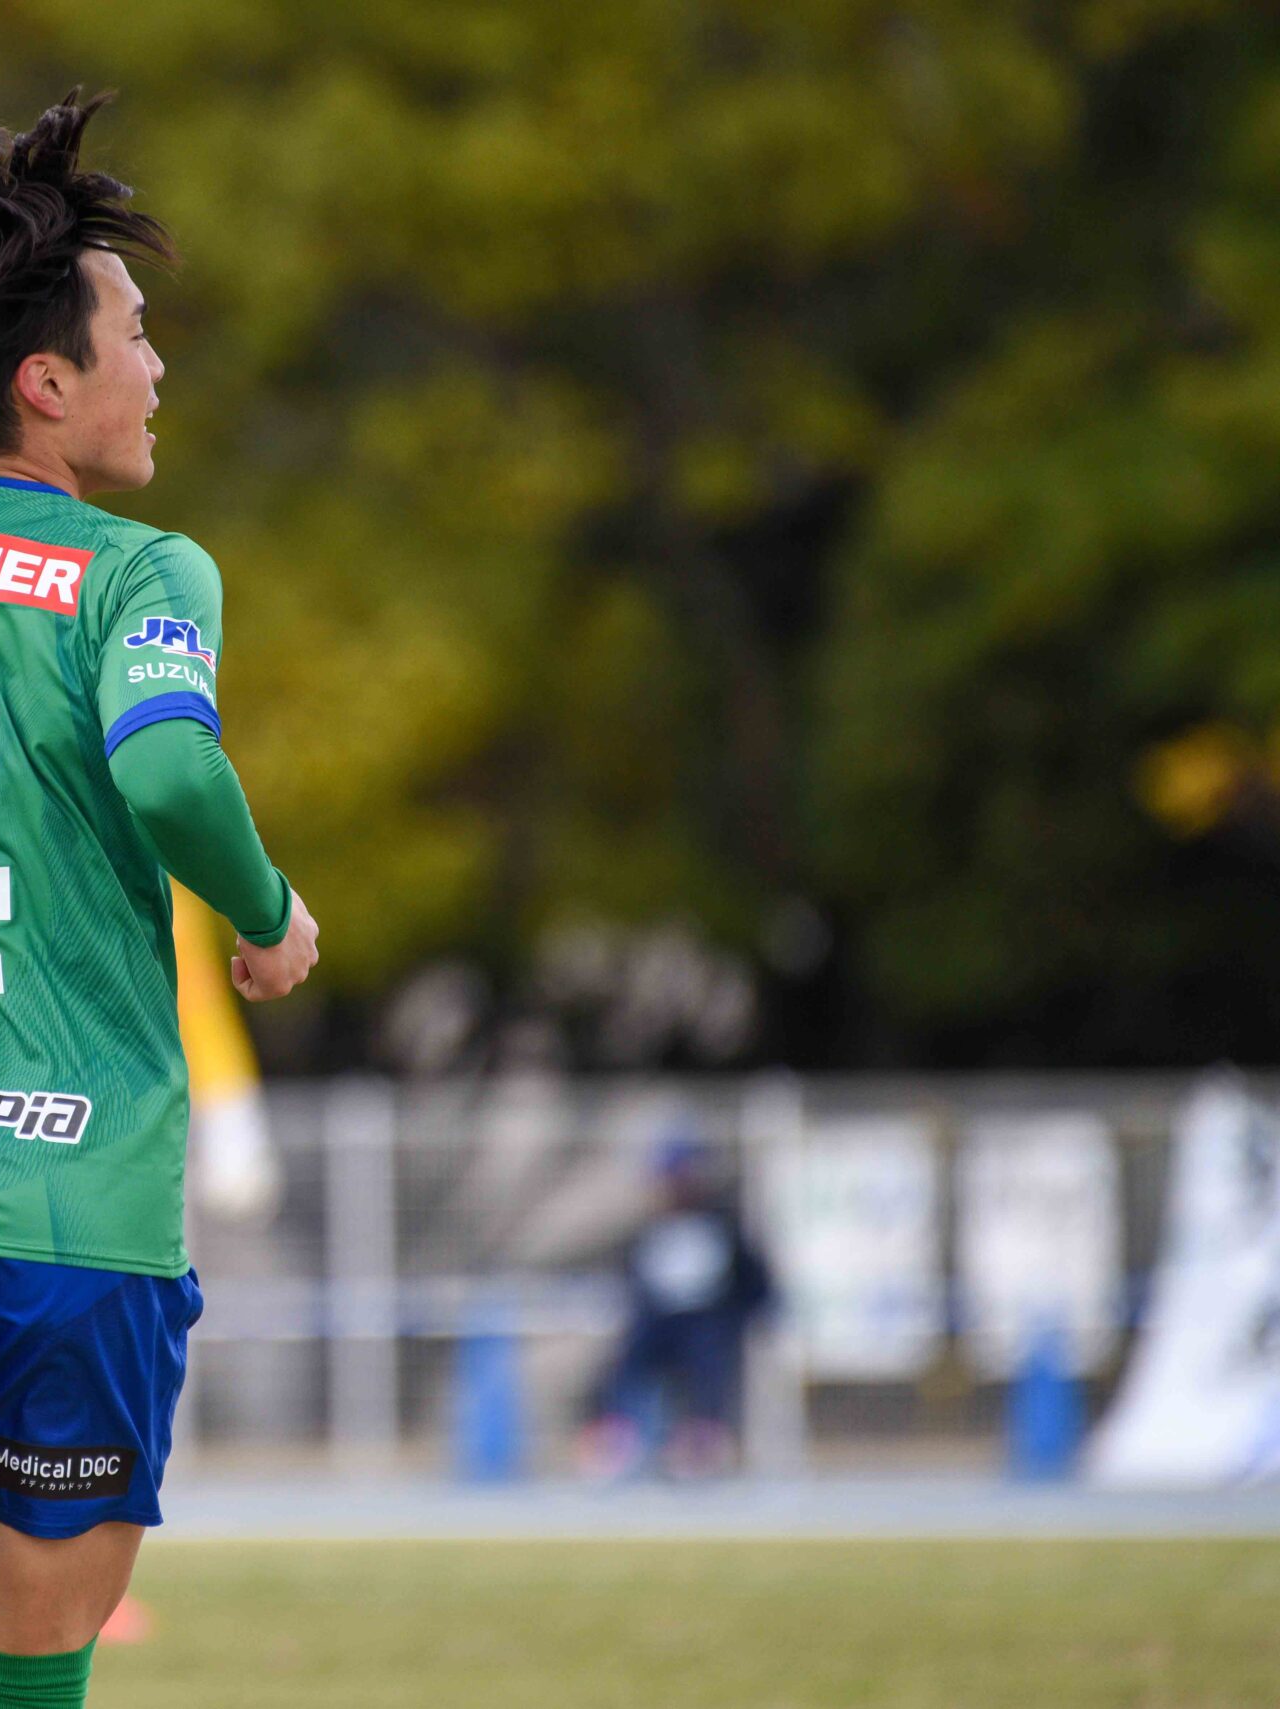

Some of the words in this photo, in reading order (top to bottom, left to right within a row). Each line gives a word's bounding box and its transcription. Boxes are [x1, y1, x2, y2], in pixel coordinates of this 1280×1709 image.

[124, 617, 215, 658] JFL
[79, 1456, 121, 1478] DOC
[20, 1478, 92, 1491] メディカルドック
